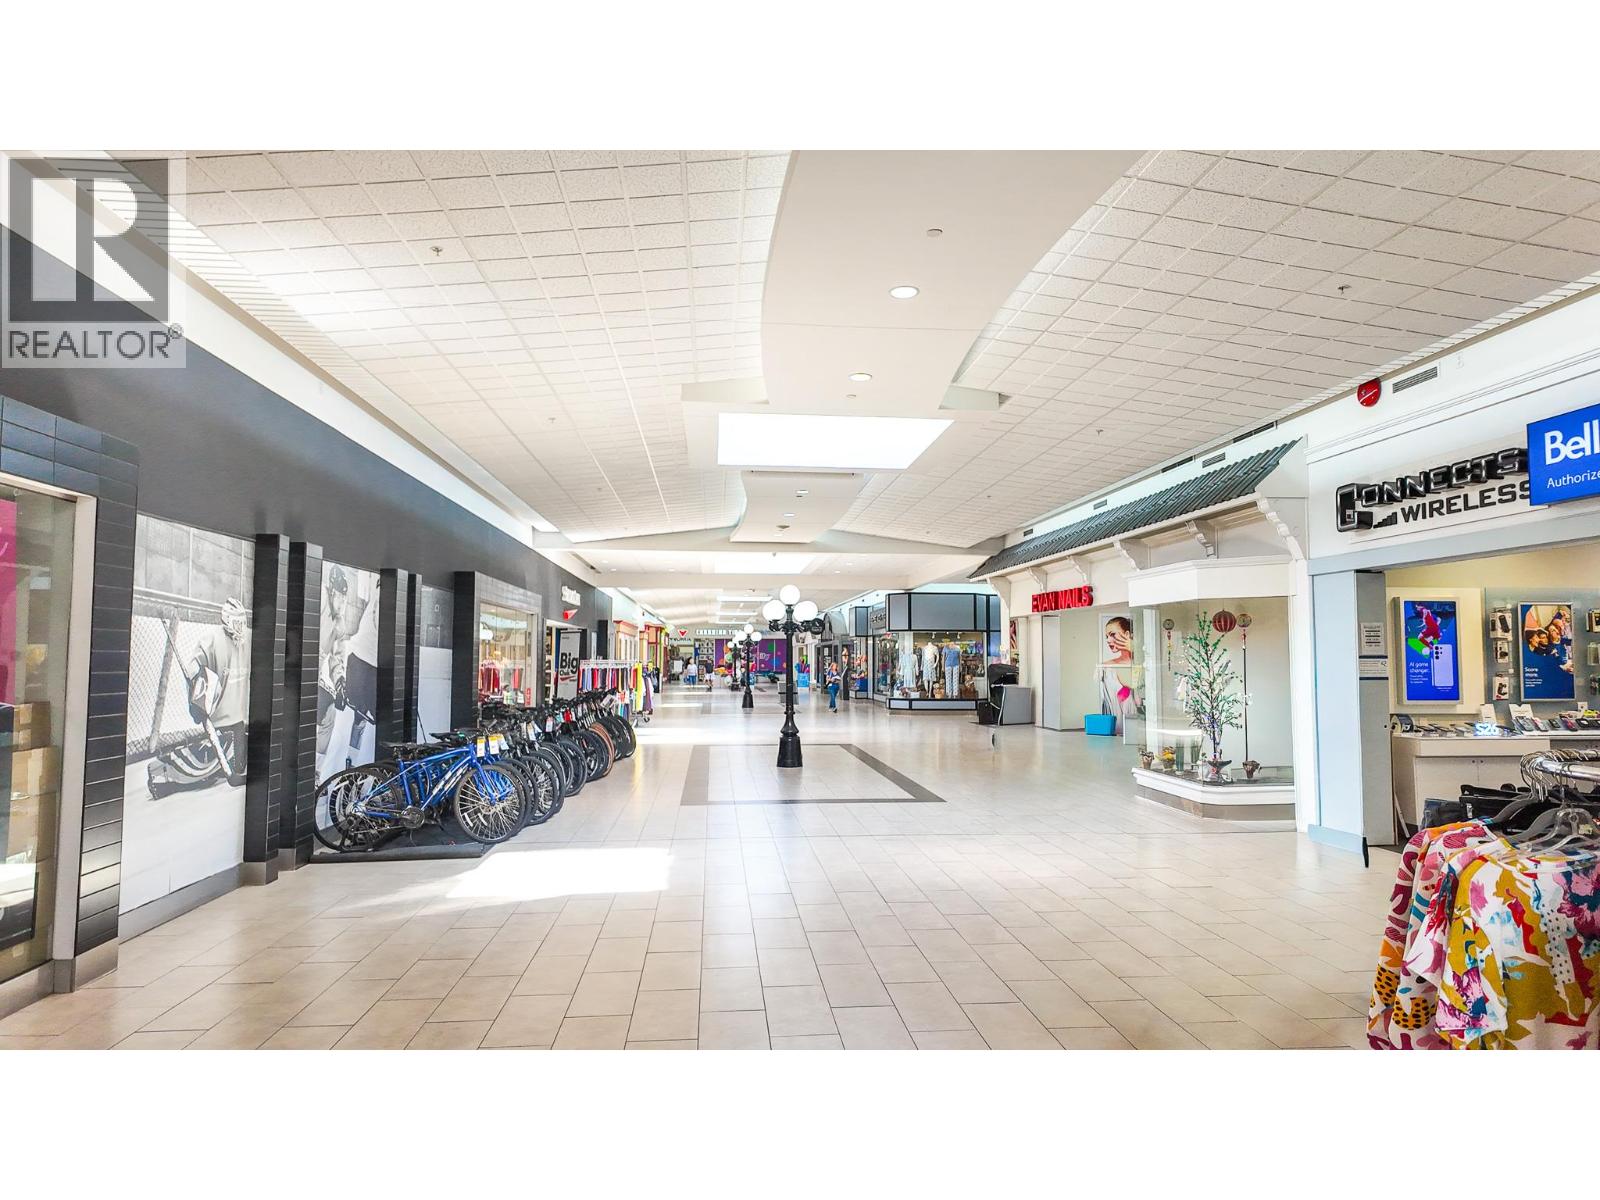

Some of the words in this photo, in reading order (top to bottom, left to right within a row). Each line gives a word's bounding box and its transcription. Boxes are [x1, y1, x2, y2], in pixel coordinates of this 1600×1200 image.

[1544, 419, 1600, 466] Bell
[1401, 480, 1530, 523] WIRELESS
[1032, 592, 1056, 613] EVAN
[1058, 585, 1093, 610] NAILS
[560, 652, 578, 674] Big
